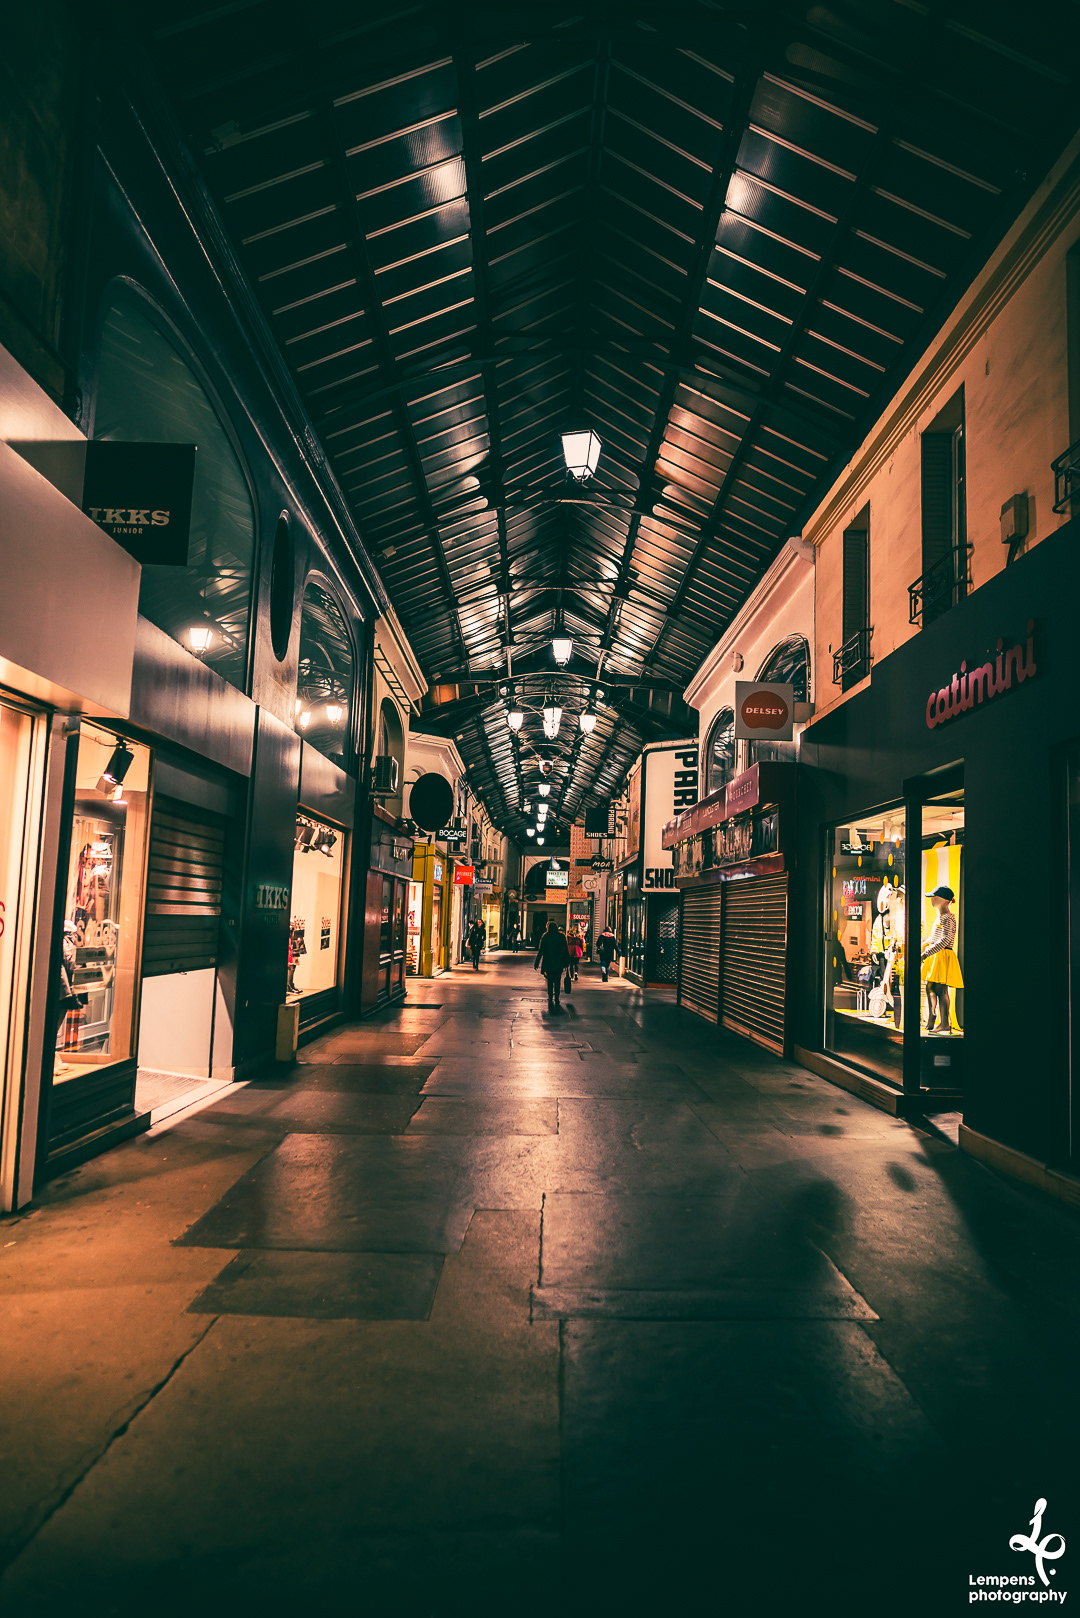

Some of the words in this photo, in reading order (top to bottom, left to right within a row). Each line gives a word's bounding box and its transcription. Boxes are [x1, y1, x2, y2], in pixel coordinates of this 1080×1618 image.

[89, 507, 170, 526] IKKS
[926, 618, 1037, 729] catimini
[745, 707, 784, 716] DELSEY
[674, 750, 699, 816] PAR
[645, 868, 678, 889] SHO
[256, 885, 289, 910] IKKS
